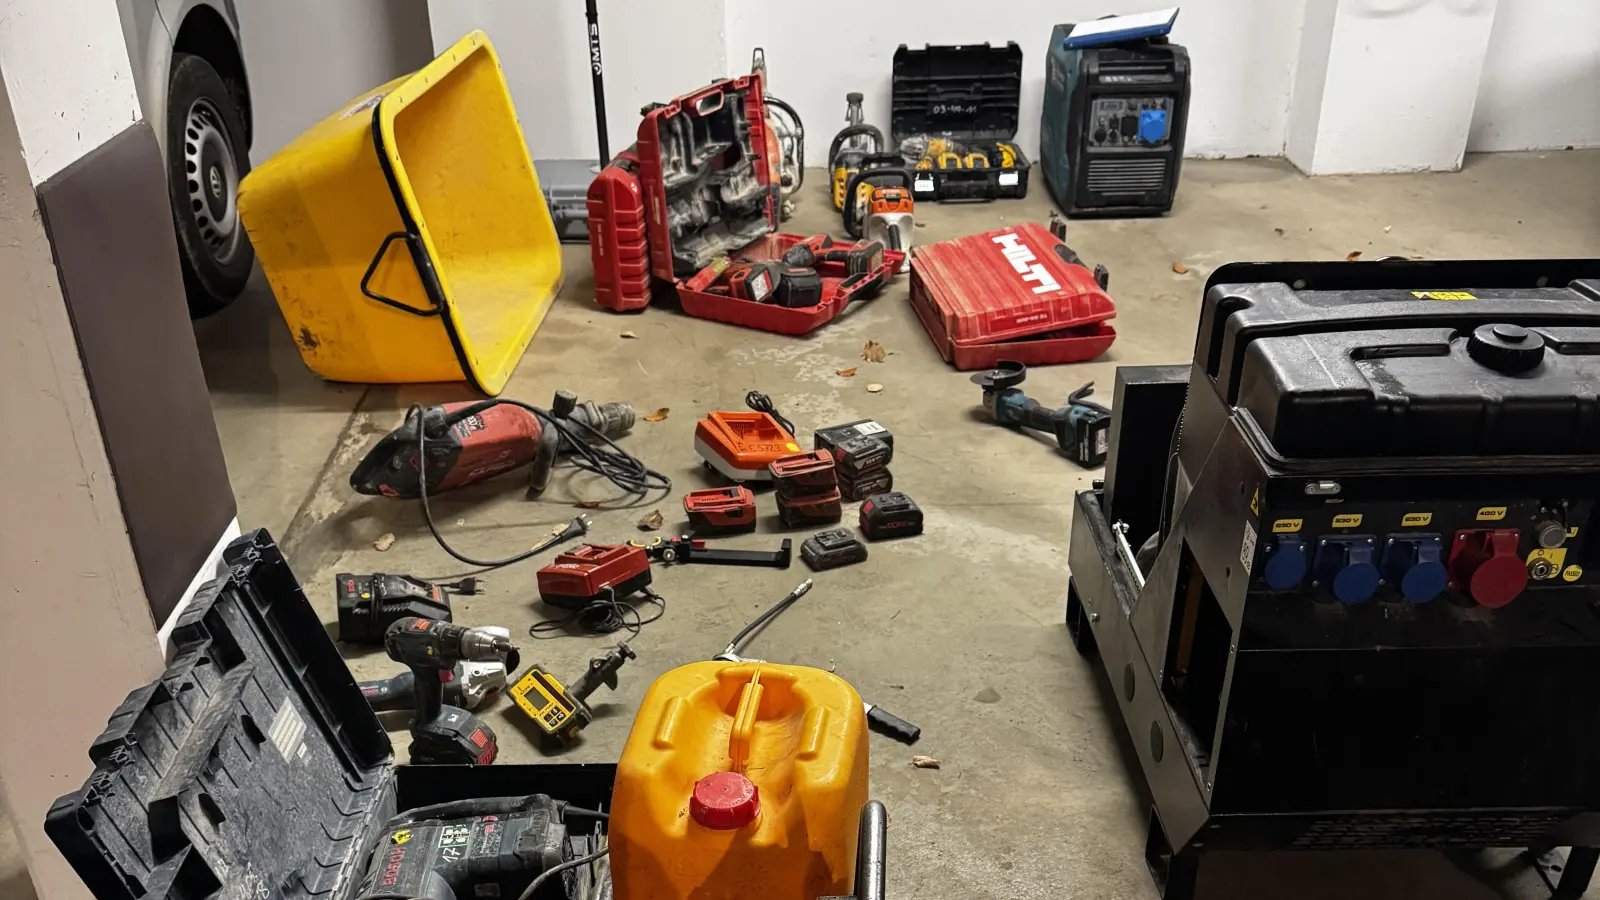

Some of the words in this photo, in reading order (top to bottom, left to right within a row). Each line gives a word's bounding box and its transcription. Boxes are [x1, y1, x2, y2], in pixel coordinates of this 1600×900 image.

[589, 23, 600, 61] MTS
[991, 233, 1062, 294] HILTI
[382, 847, 406, 887] BOSCH
